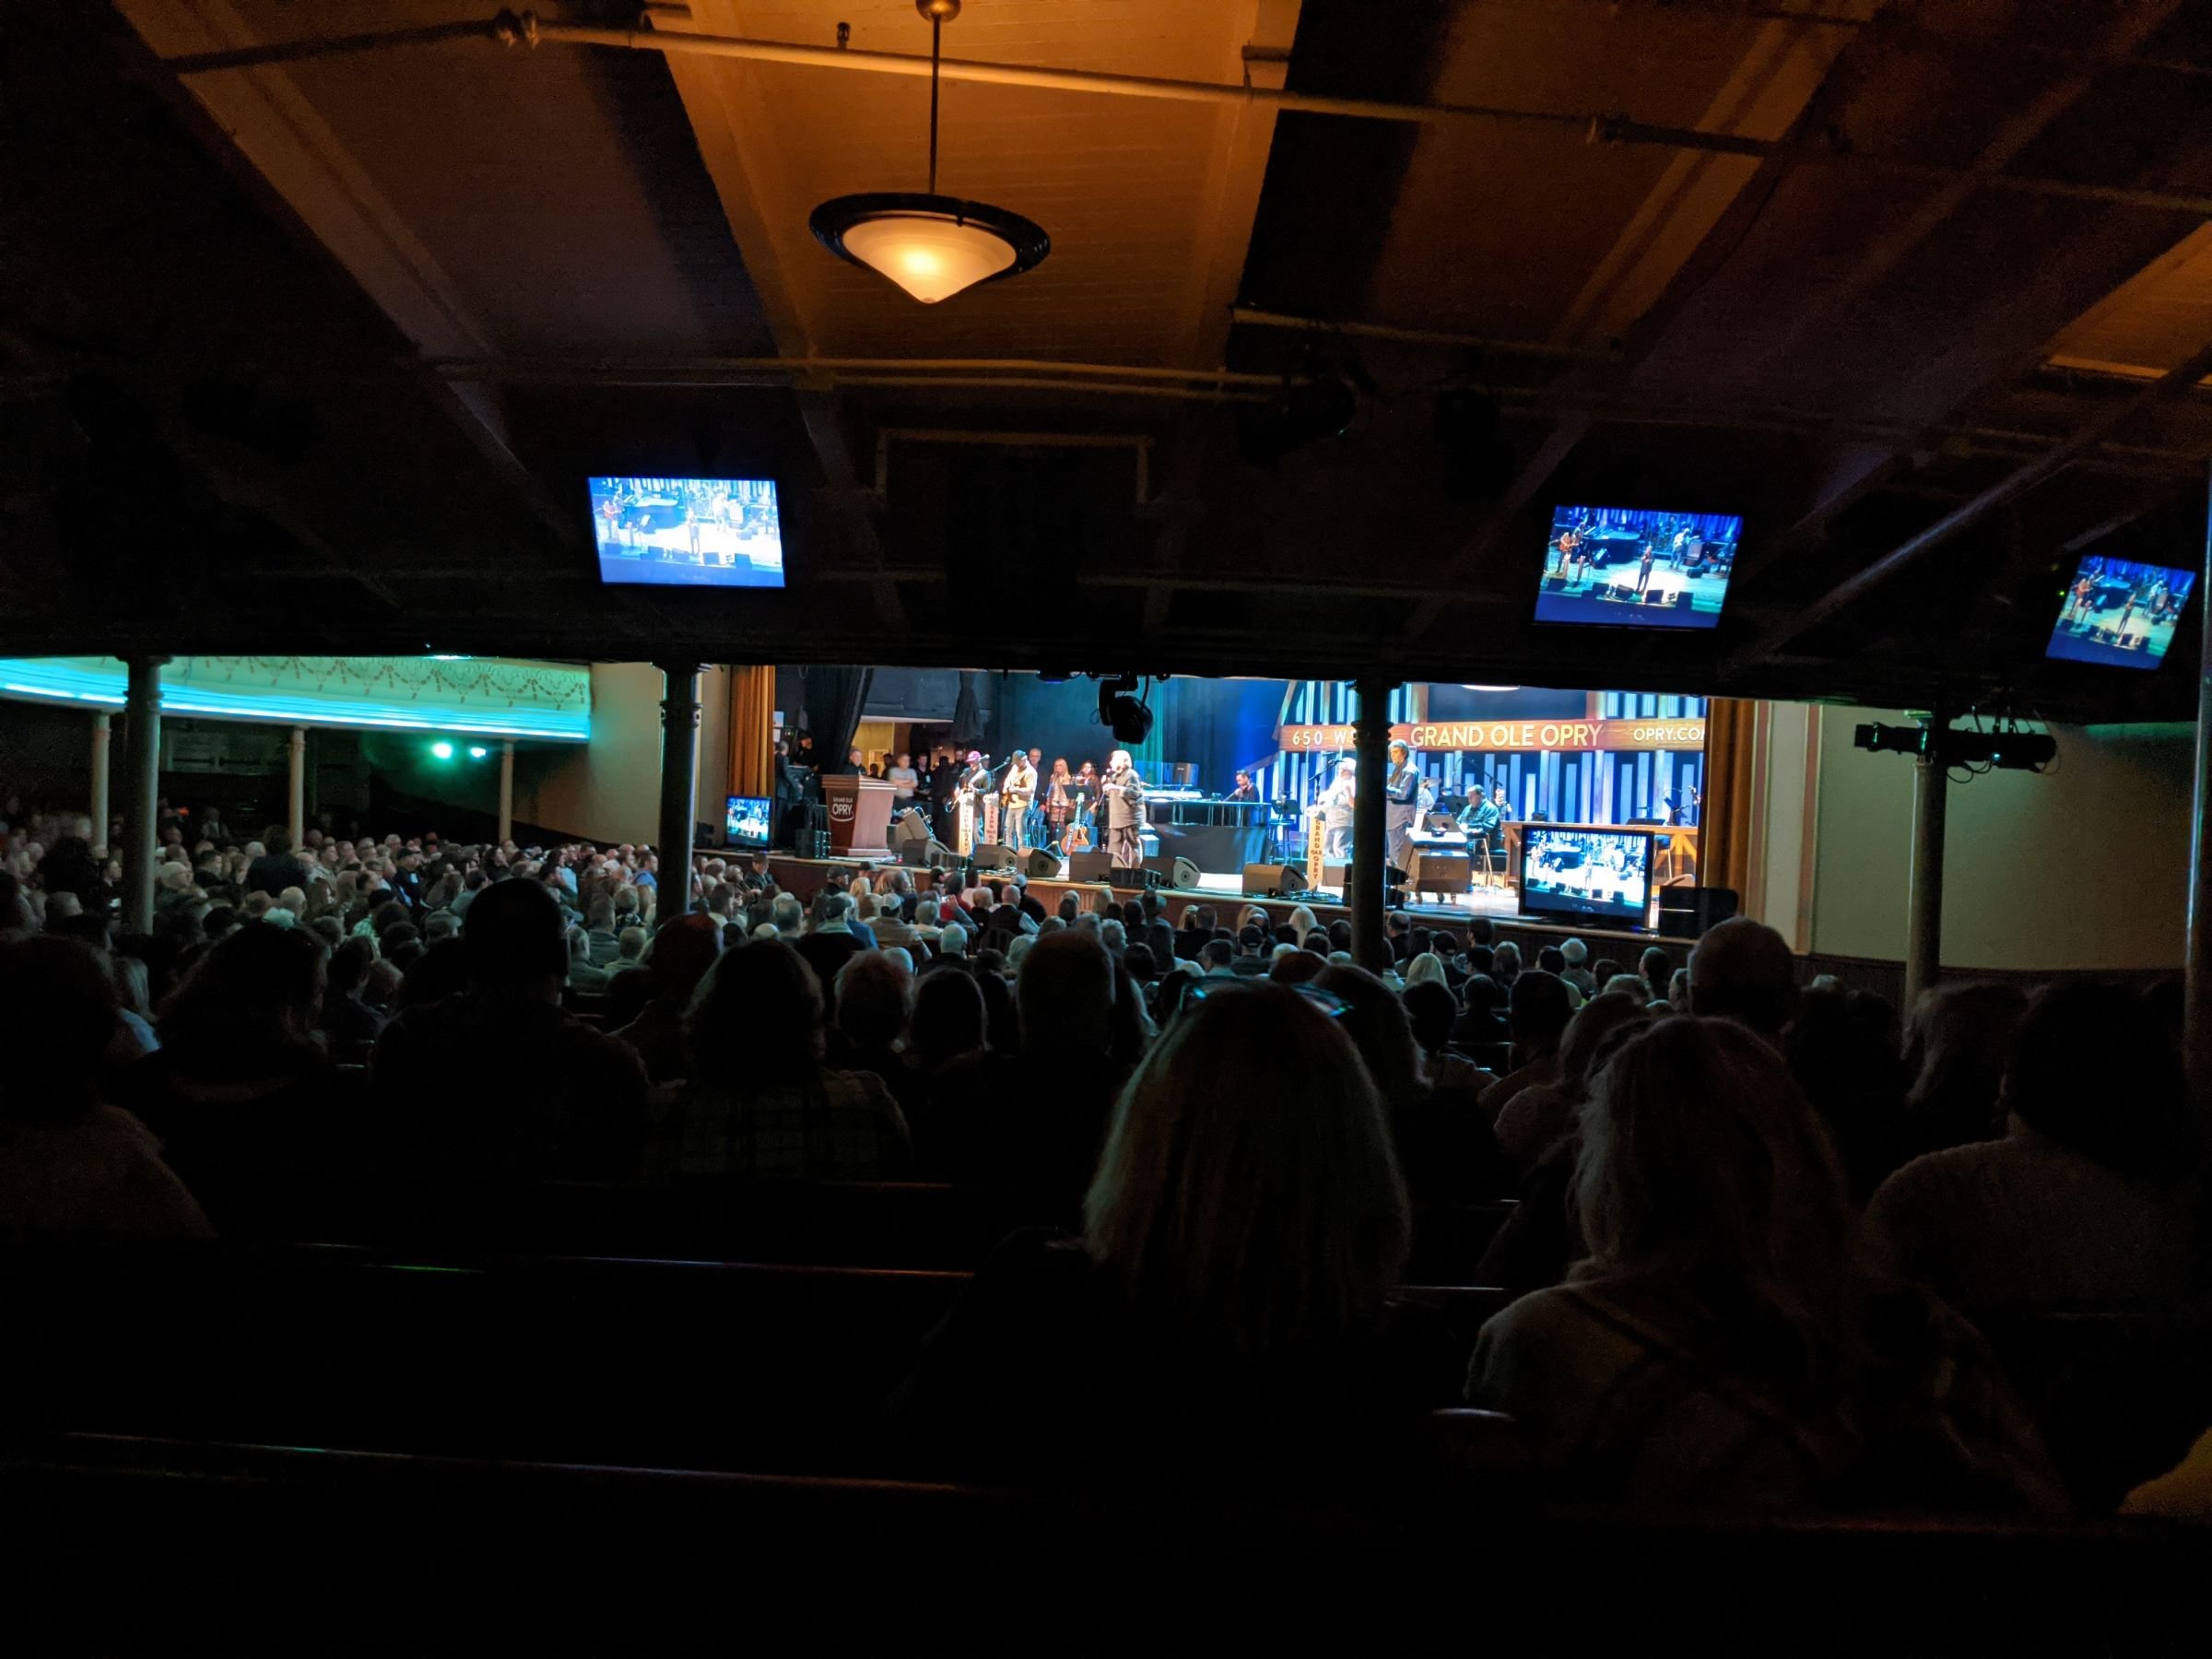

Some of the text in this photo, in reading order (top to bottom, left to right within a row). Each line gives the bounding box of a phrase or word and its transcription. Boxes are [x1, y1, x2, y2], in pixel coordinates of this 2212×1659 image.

[1292, 730, 1323, 746] 650
[1410, 724, 1604, 747] GRAND OLE OPRY
[832, 803, 853, 816] OPRY
